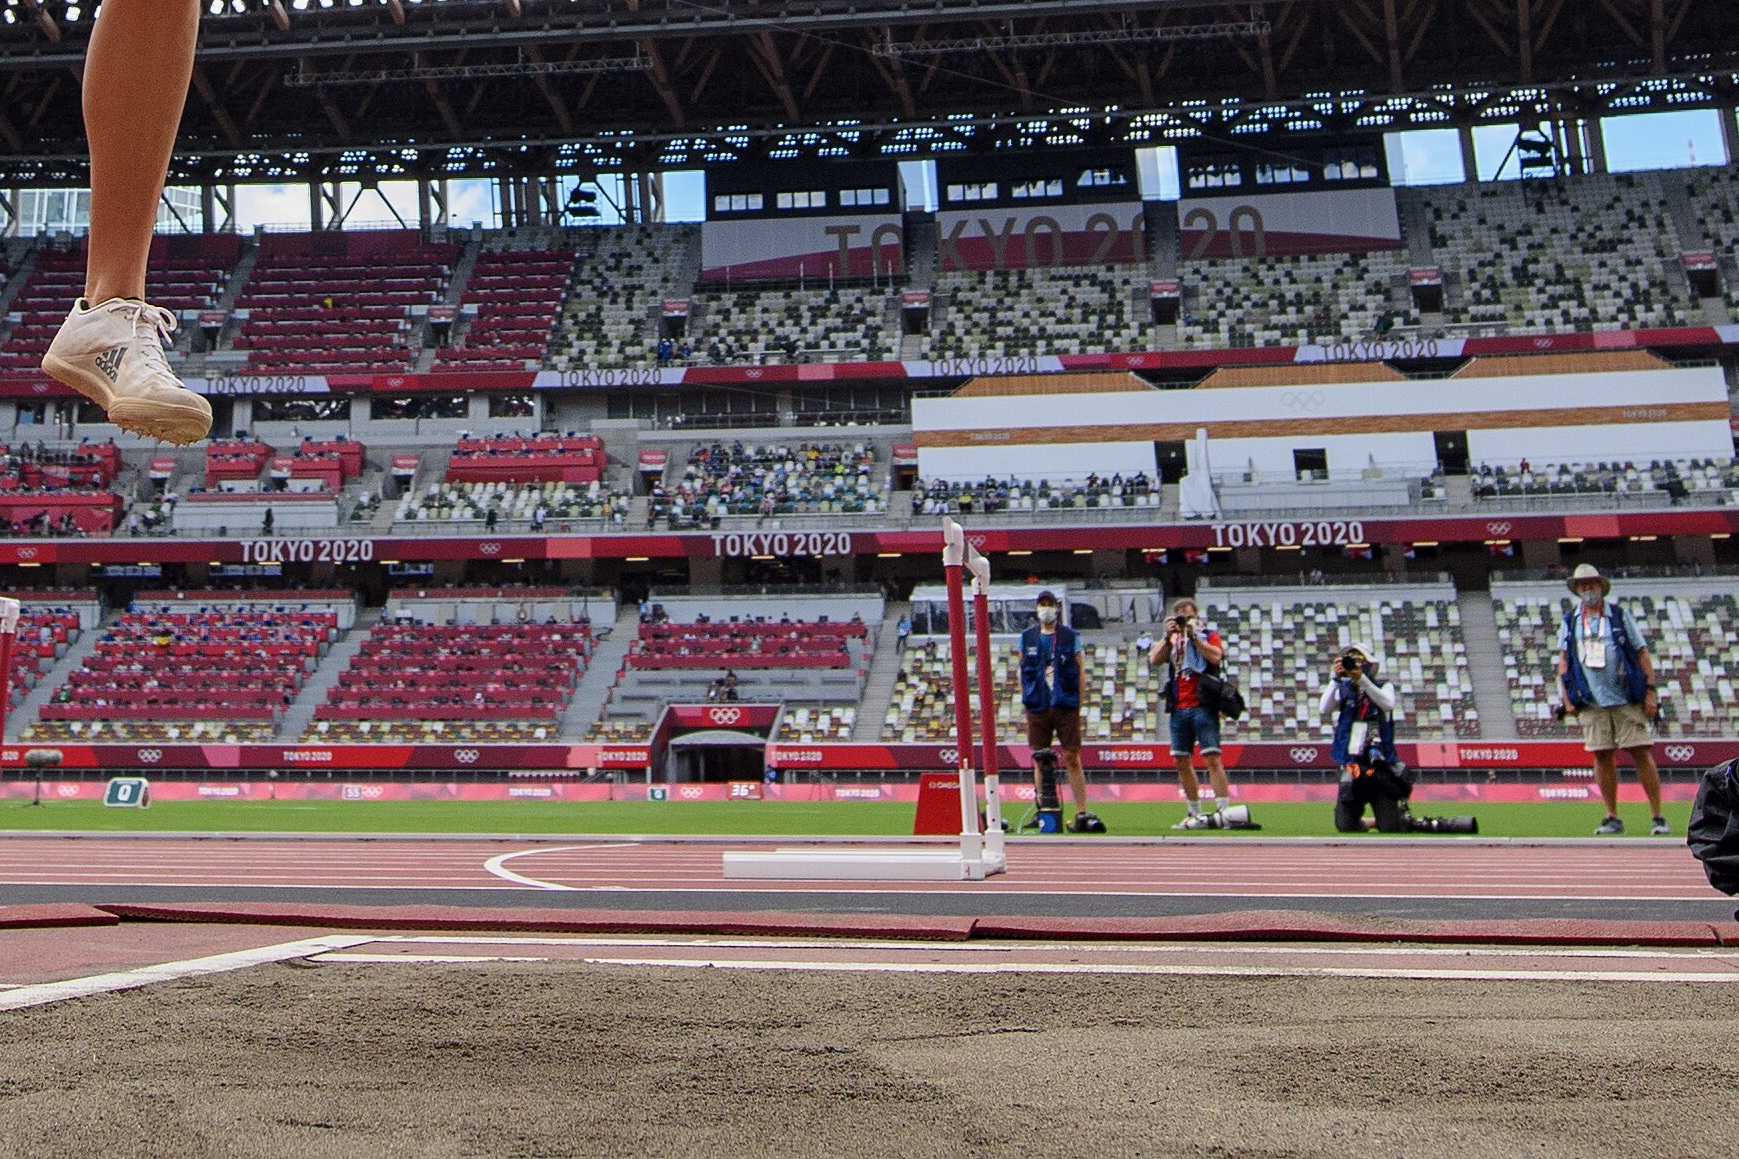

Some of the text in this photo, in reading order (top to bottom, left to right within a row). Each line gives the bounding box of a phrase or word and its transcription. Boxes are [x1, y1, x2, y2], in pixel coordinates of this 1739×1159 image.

[1320, 340, 1438, 363] TOKYO 2020
[94, 356, 119, 384] adidas
[557, 367, 662, 387] TOKYO 2020
[928, 357, 1038, 377] TOKYO 2020
[204, 376, 306, 394] TOKYO 2020
[711, 531, 851, 557] TOKYO 2020
[1211, 521, 1363, 547] TOKYO 2020
[240, 540, 374, 562] TOKYO 2020
[1098, 750, 1154, 761] TOKYO 2020
[1459, 749, 1518, 760] TOKYO 2020
[117, 784, 133, 801] 0
